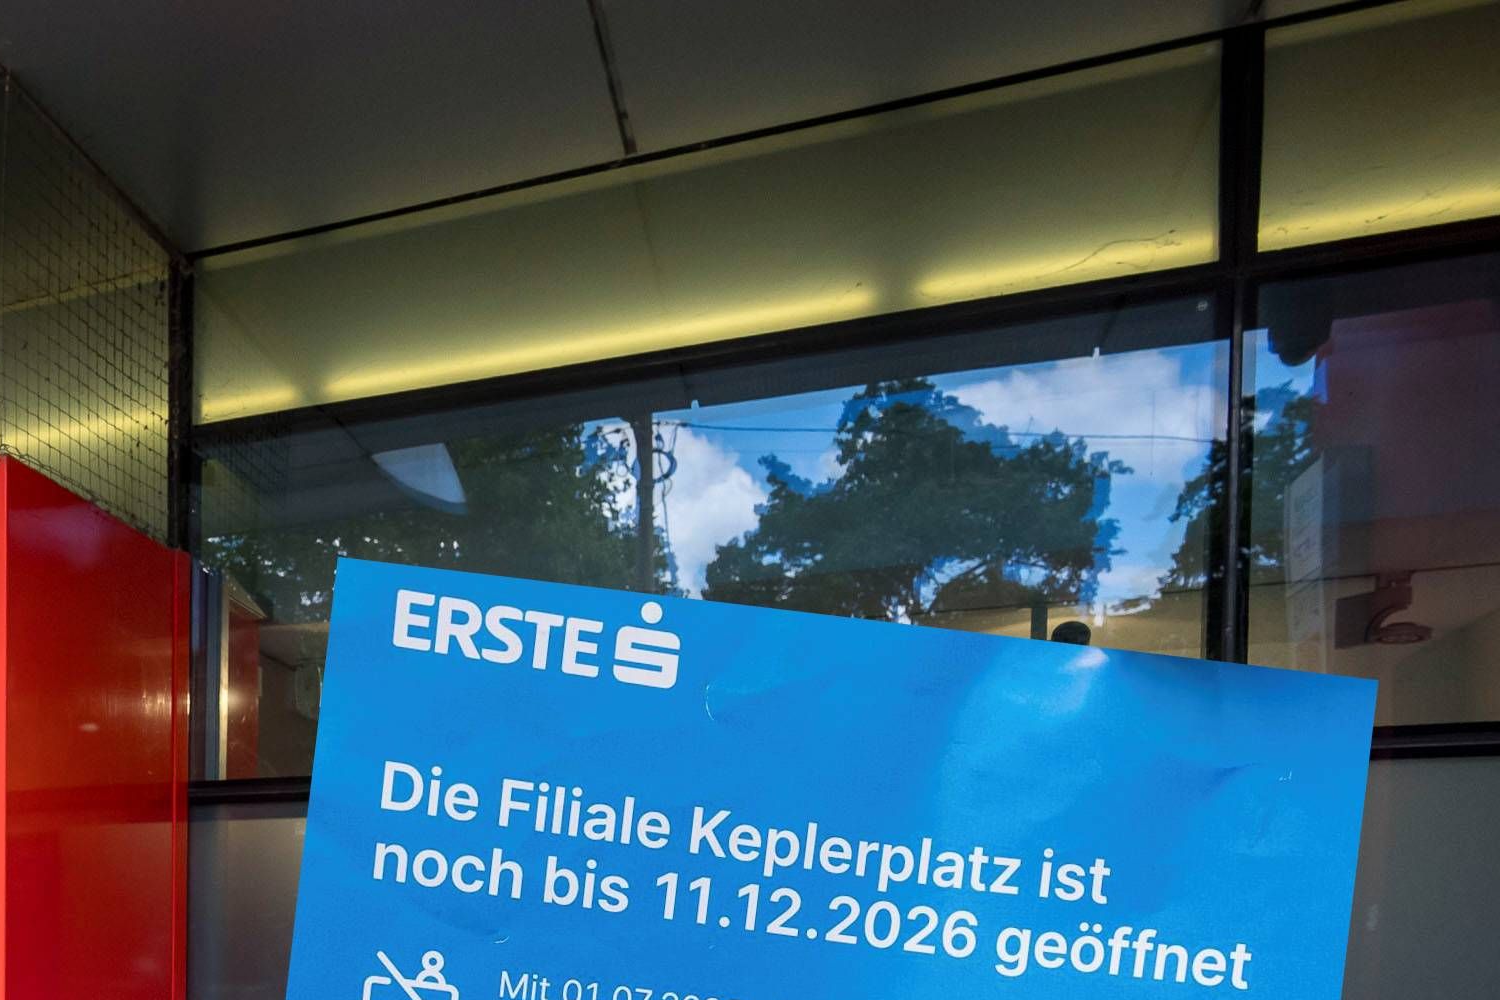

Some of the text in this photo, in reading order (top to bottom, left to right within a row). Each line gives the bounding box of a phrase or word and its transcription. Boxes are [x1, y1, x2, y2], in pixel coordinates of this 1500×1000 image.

[391, 588, 605, 679] ERSTE
[379, 759, 1112, 906] Die Filiale Keplerplatz ist
[372, 841, 1254, 991] noch bis 11.12.2026 geöffnet
